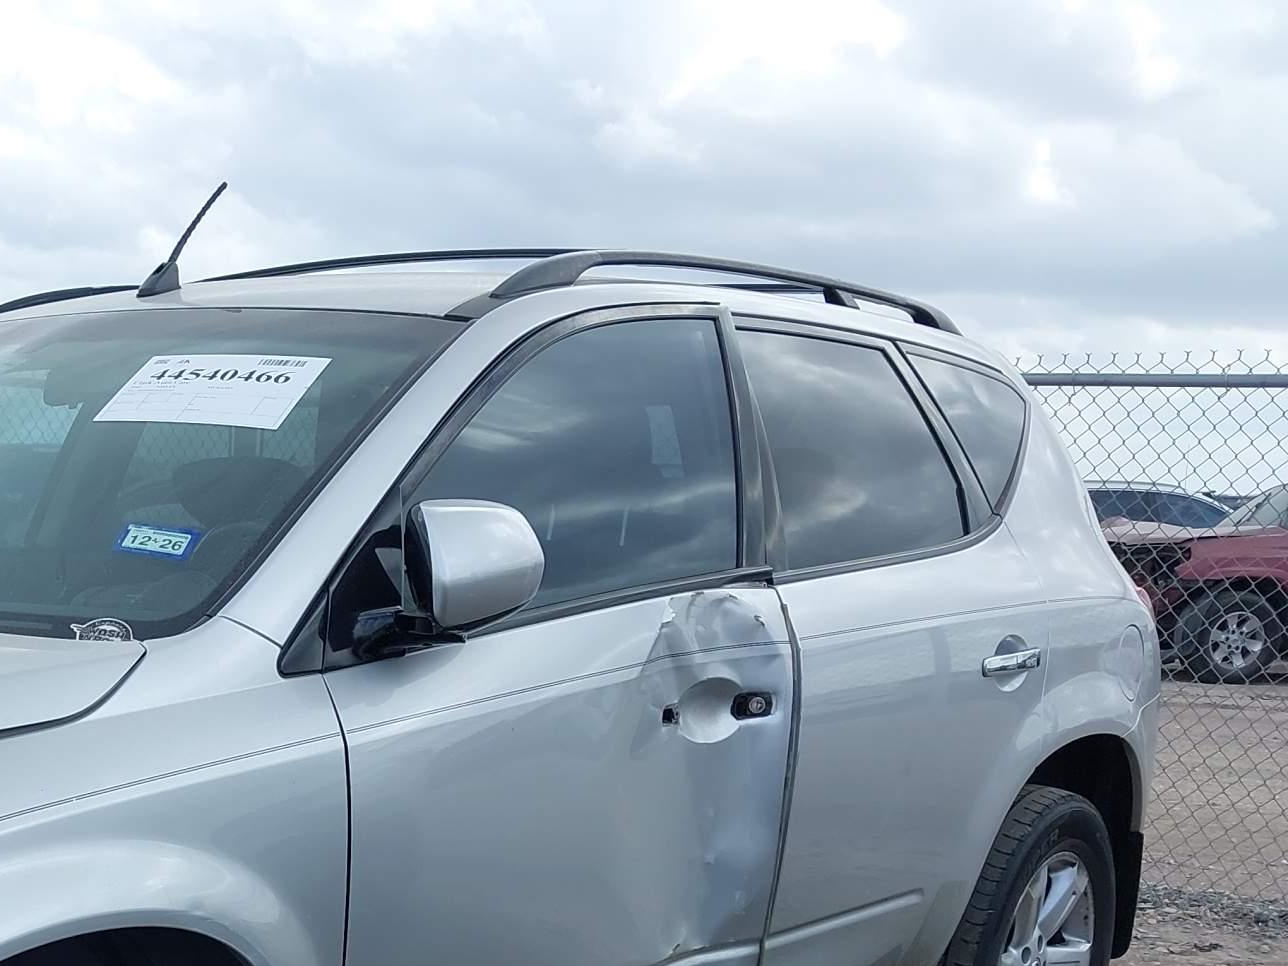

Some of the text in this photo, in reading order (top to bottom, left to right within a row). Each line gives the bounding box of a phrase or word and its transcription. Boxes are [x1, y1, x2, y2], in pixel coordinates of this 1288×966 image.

[150, 367, 297, 385] 44540466
[130, 534, 153, 547] 12
[158, 538, 184, 552] 26
